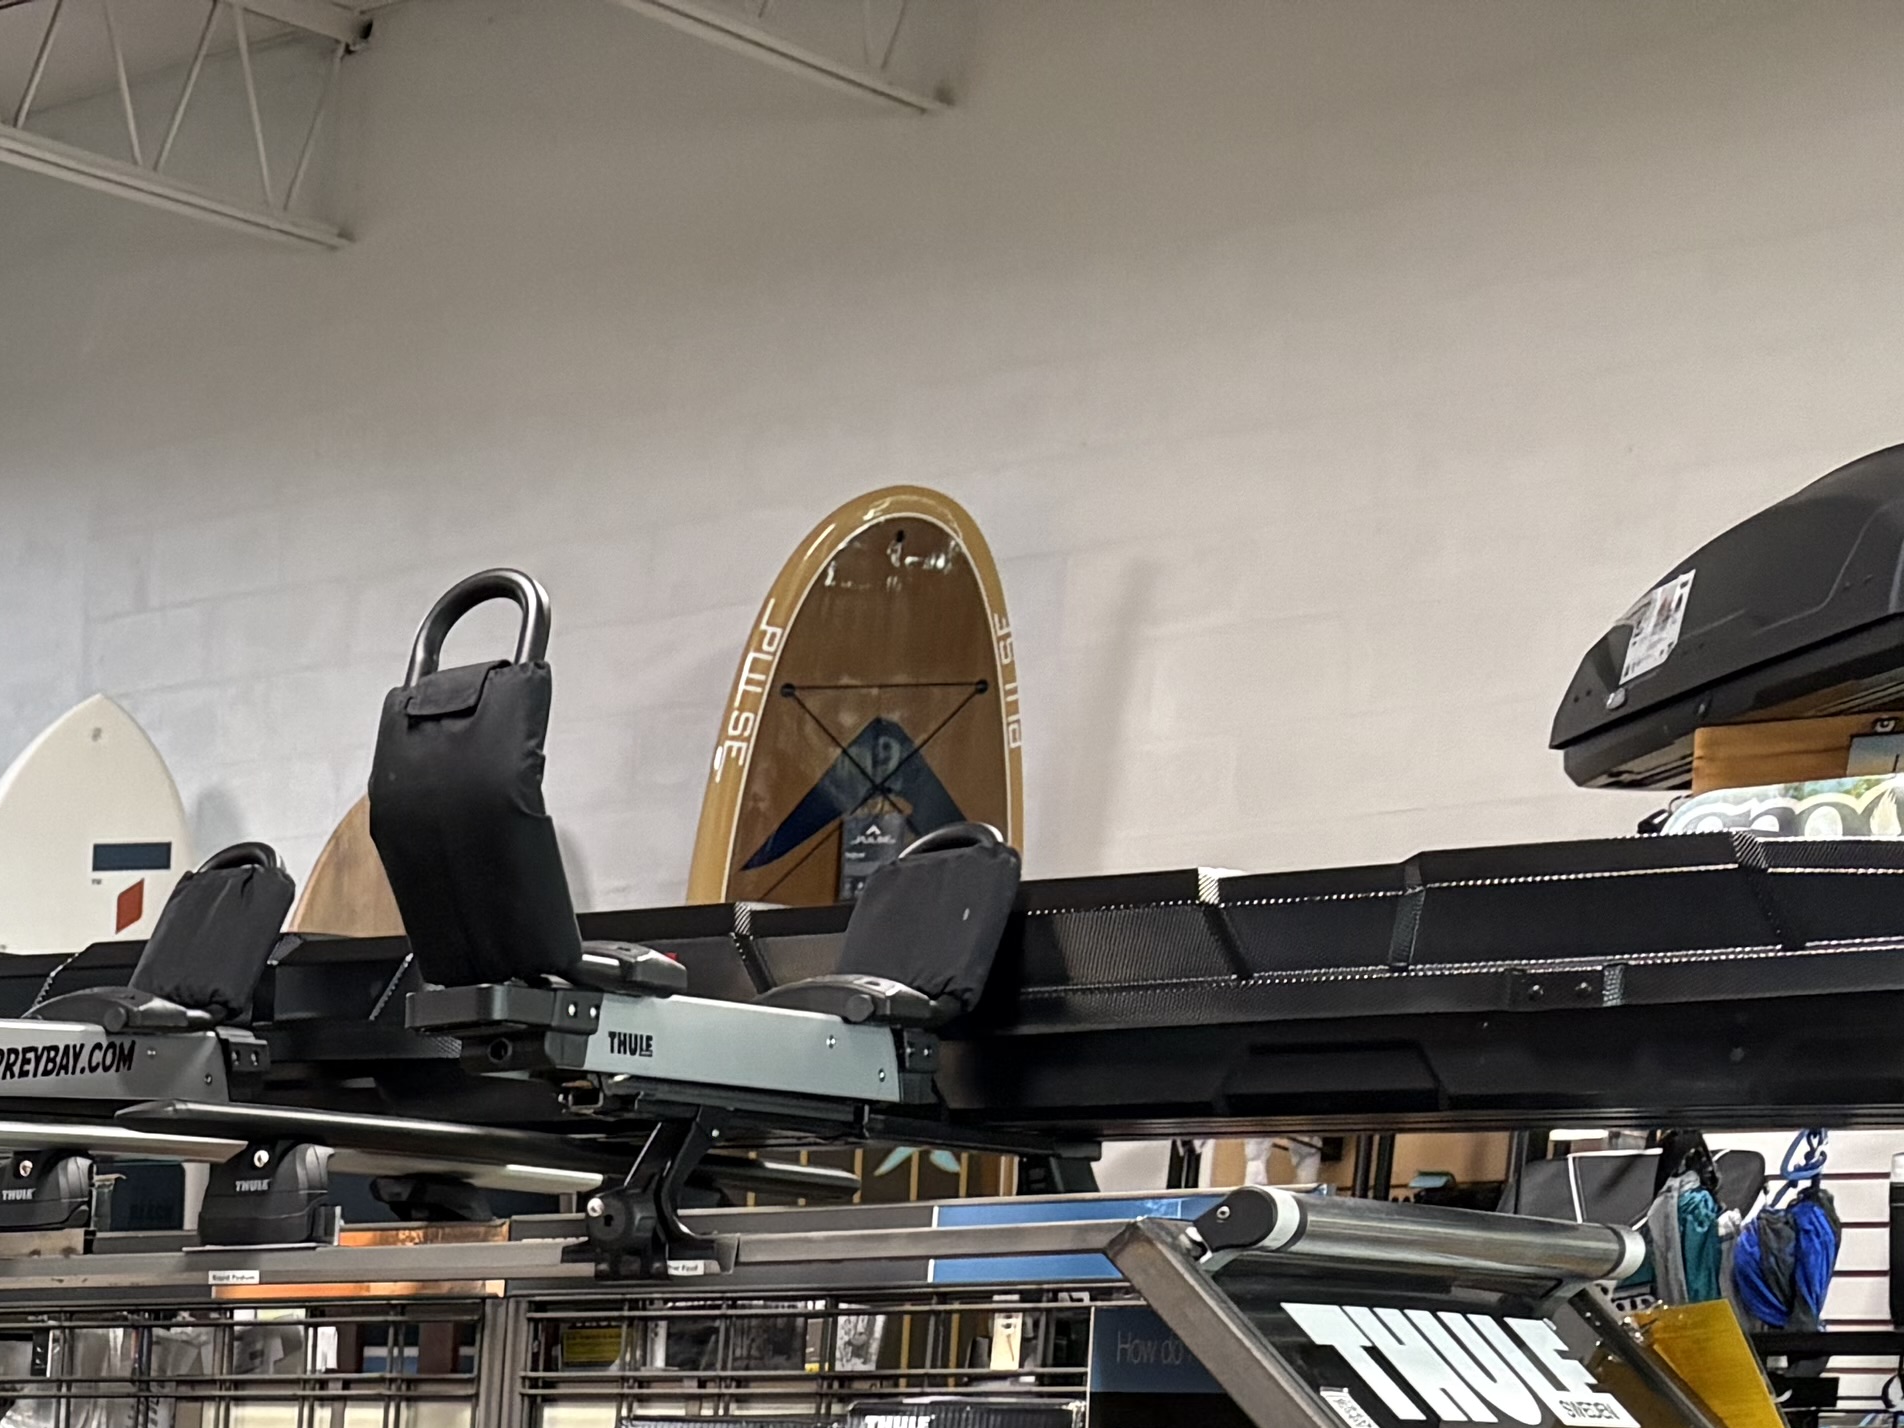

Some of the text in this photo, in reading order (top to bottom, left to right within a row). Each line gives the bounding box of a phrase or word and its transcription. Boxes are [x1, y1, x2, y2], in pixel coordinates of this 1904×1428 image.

[607, 1031, 654, 1057] THULE
[1280, 1302, 1623, 1428] THULE
[1558, 1400, 1622, 1422] SWEDEN
